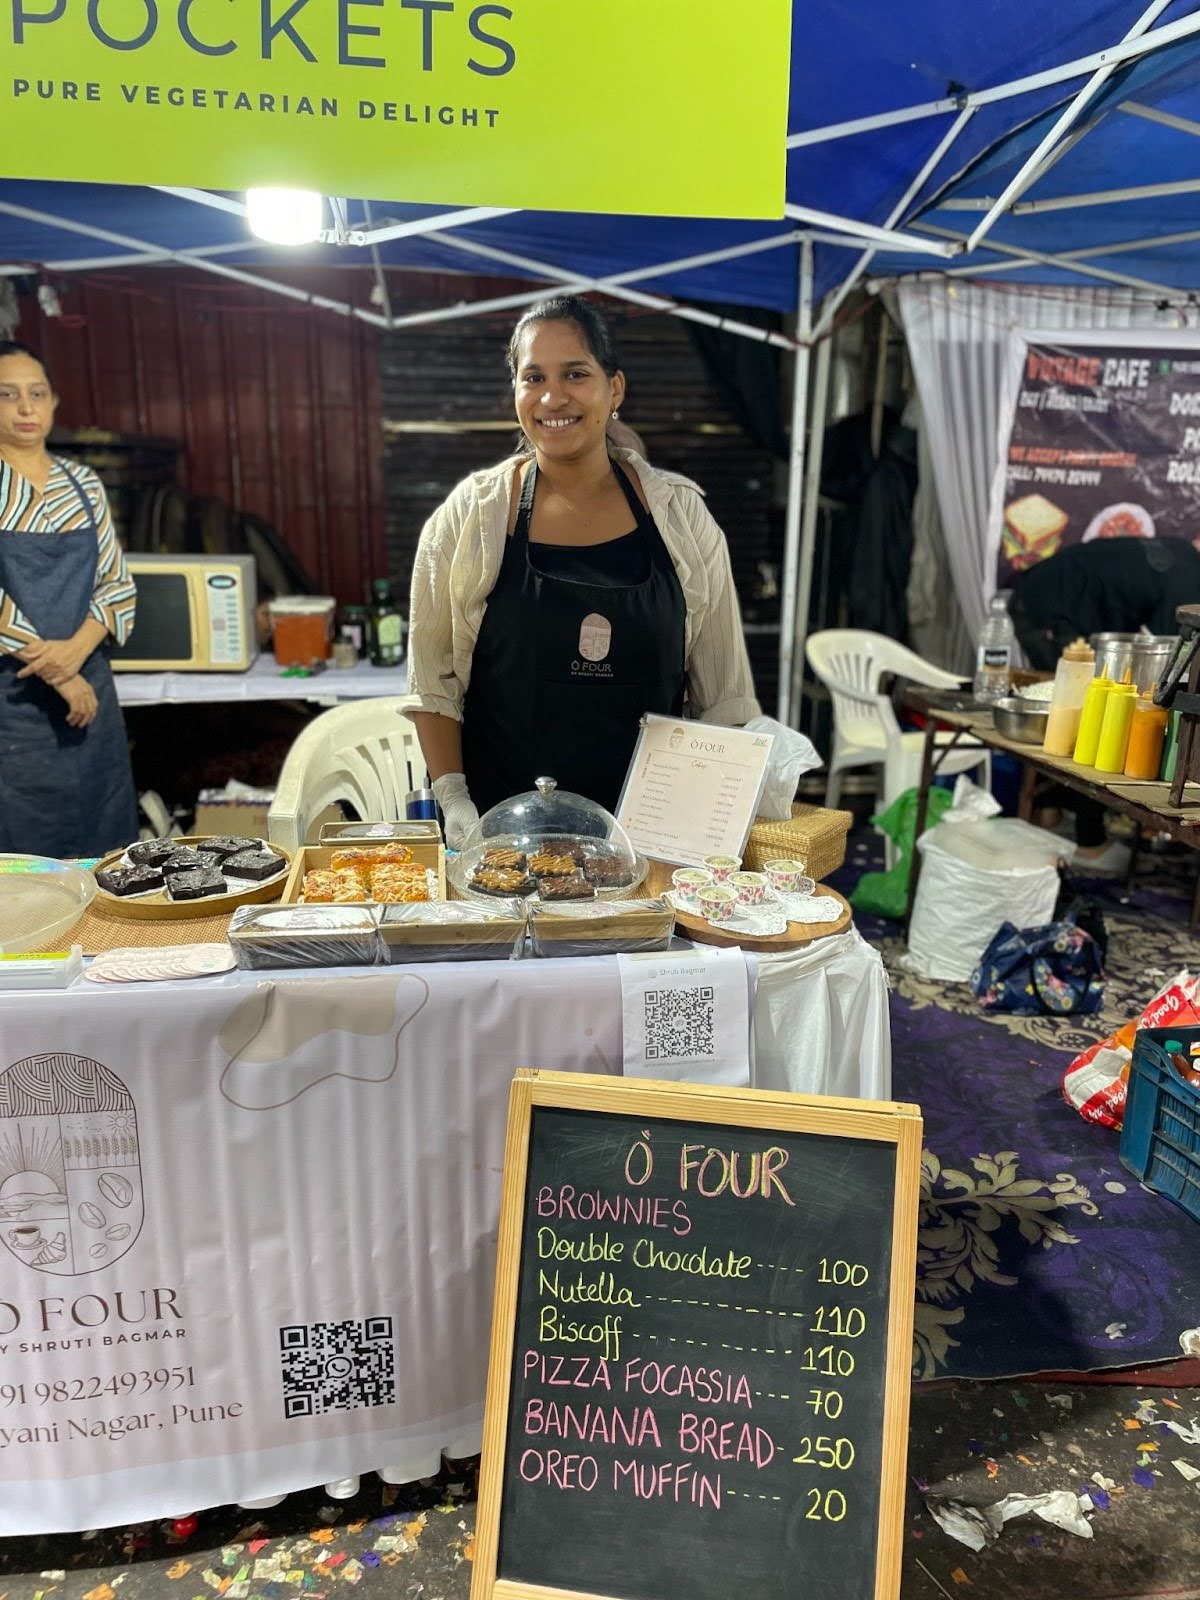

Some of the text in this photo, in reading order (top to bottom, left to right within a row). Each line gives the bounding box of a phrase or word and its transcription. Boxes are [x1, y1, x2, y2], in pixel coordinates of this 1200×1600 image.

[11, 0, 517, 76] POCKETS
[13, 78, 501, 128] PURE VEGETARIAN DELIGHT
[1103, 358, 1150, 387] CAFE
[582, 662, 612, 672] FOUR
[700, 741, 725, 753] FOUR
[1150, 994, 1180, 1024] Good
[680, 1143, 796, 1206] FOUR
[535, 1184, 692, 1236] BROWNIES
[538, 1226, 869, 1286] Double Chocolate 100
[38, 1288, 183, 1331] FOUR
[538, 1269, 866, 1337] Nutella 110
[19, 1338, 91, 1352] SHRUTI
[103, 1329, 186, 1346] BAGMAR
[539, 1305, 854, 1377] Biscoff 110
[34, 1366, 196, 1406] 9822493951
[523, 1350, 843, 1419] PIZZA FOCASSIA 70
[67, 1412, 163, 1440] Nagar,
[172, 1402, 243, 1424] Pune
[524, 1398, 855, 1469] BANANA BREAD 250
[519, 1449, 847, 1521] OREO MUFFIN 20
